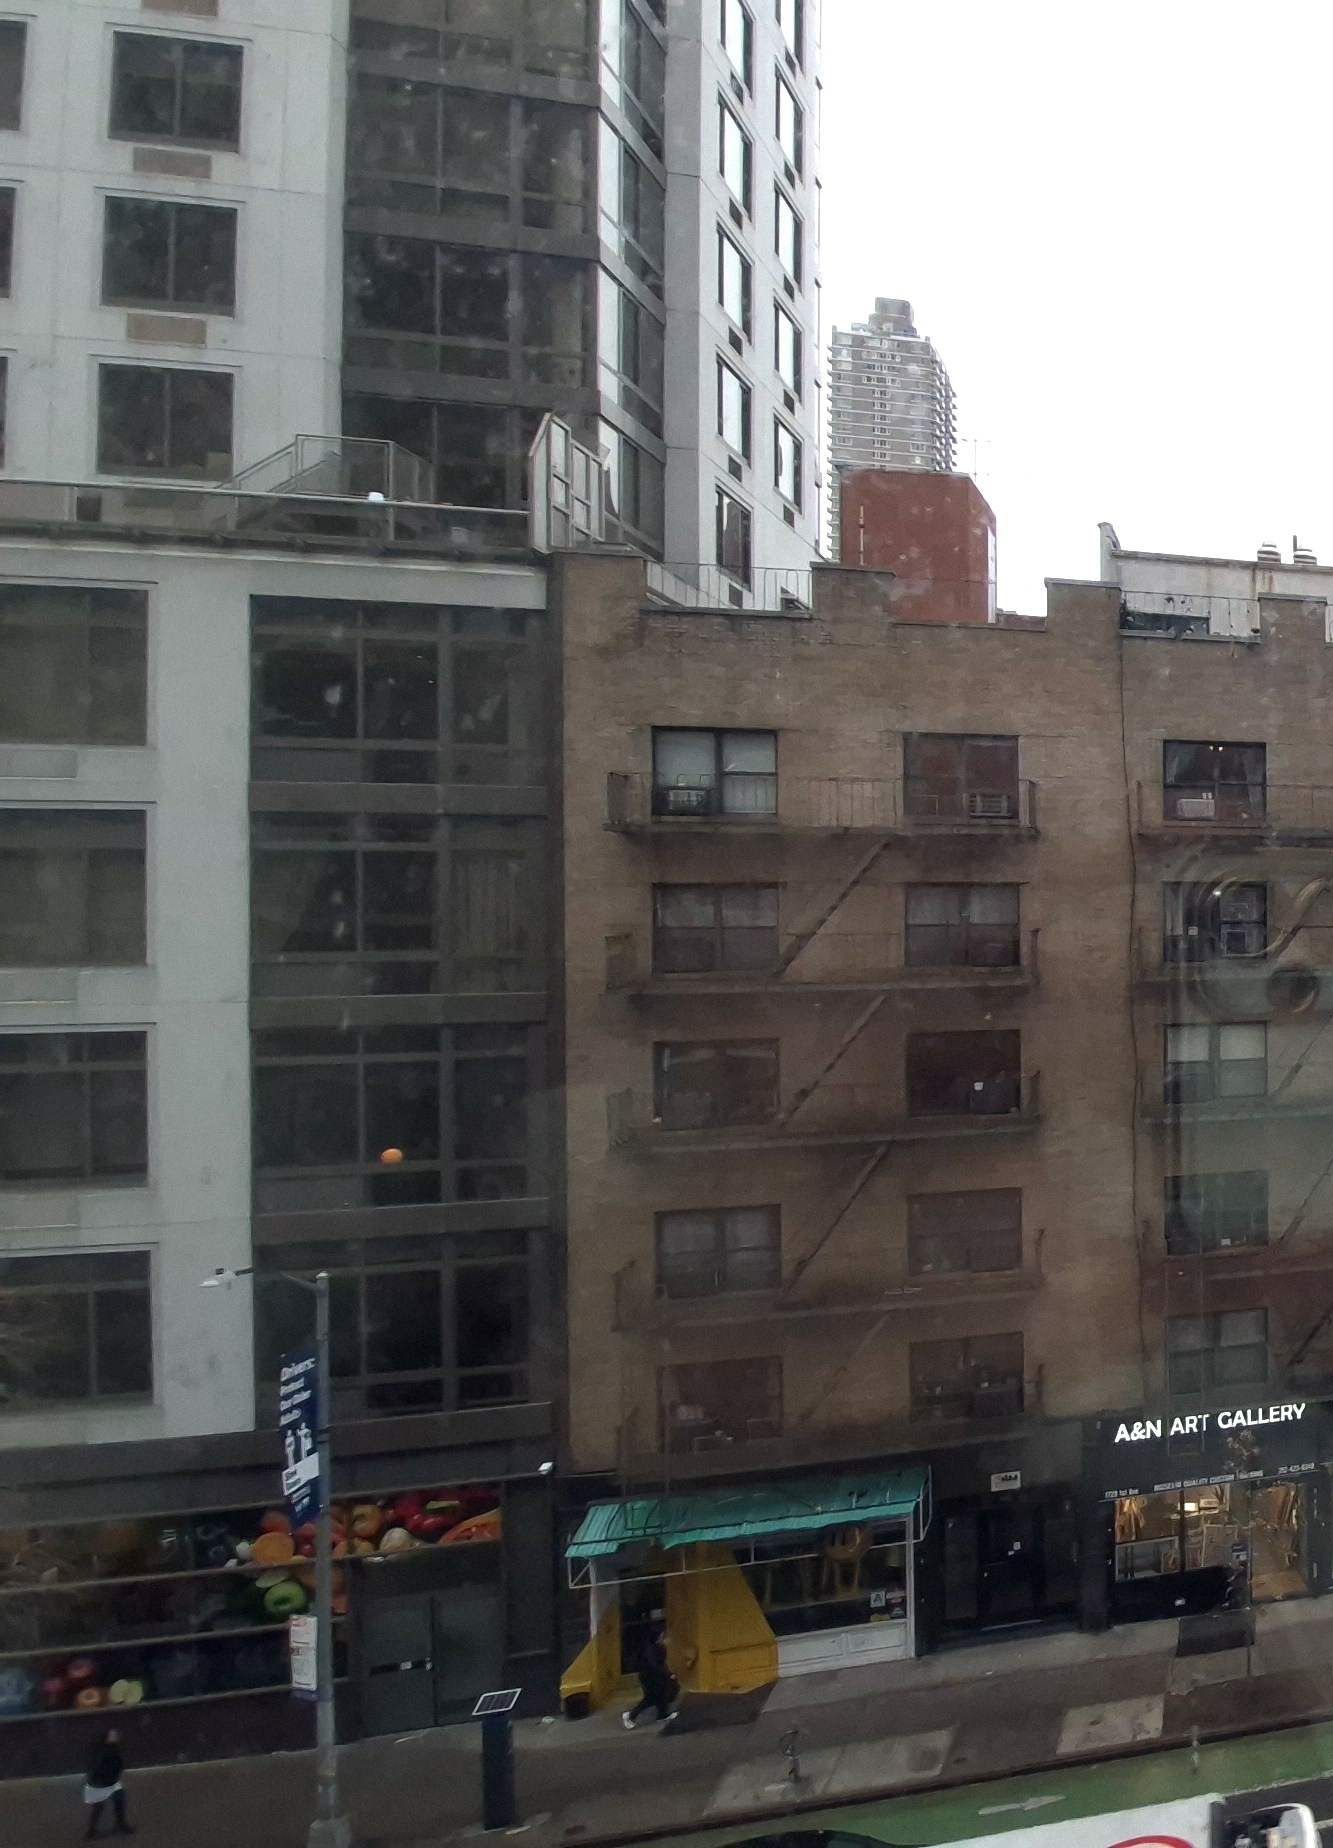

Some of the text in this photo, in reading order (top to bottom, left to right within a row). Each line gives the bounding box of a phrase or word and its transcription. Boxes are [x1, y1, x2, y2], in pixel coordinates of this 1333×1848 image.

[1114, 1403, 1306, 1443] A&N ART GALLERY
